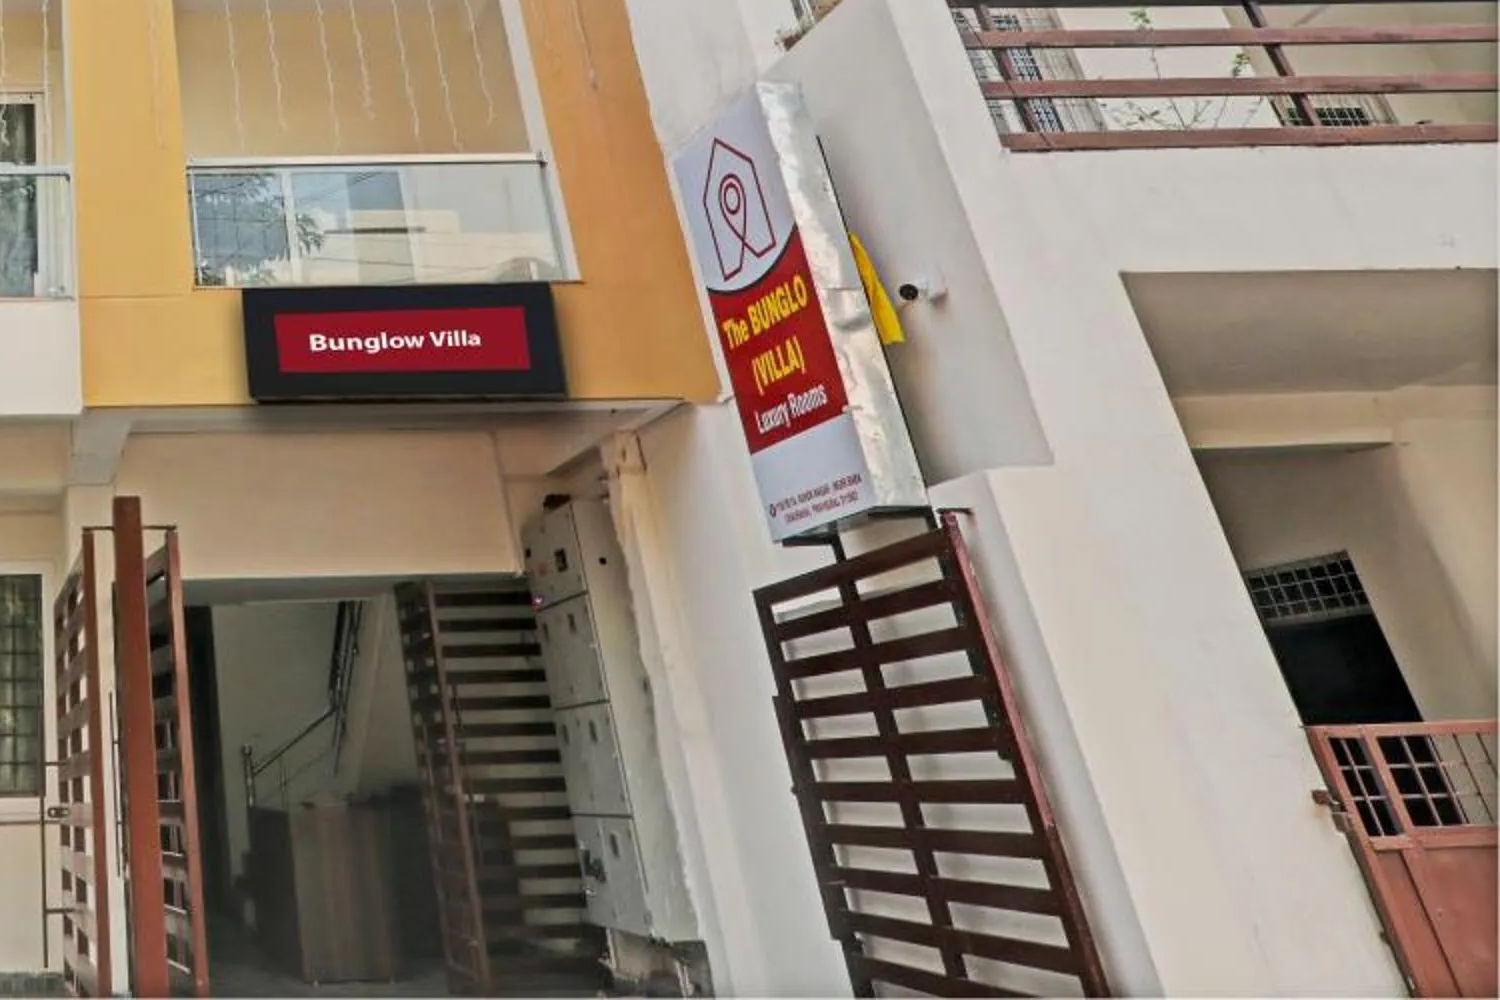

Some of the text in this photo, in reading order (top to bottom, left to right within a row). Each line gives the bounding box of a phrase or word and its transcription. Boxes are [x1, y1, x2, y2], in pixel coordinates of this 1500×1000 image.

[723, 275, 807, 350] The BUNGLO
[309, 330, 481, 354] Bunglow Villa
[754, 384, 828, 433] Luxury Rooms
